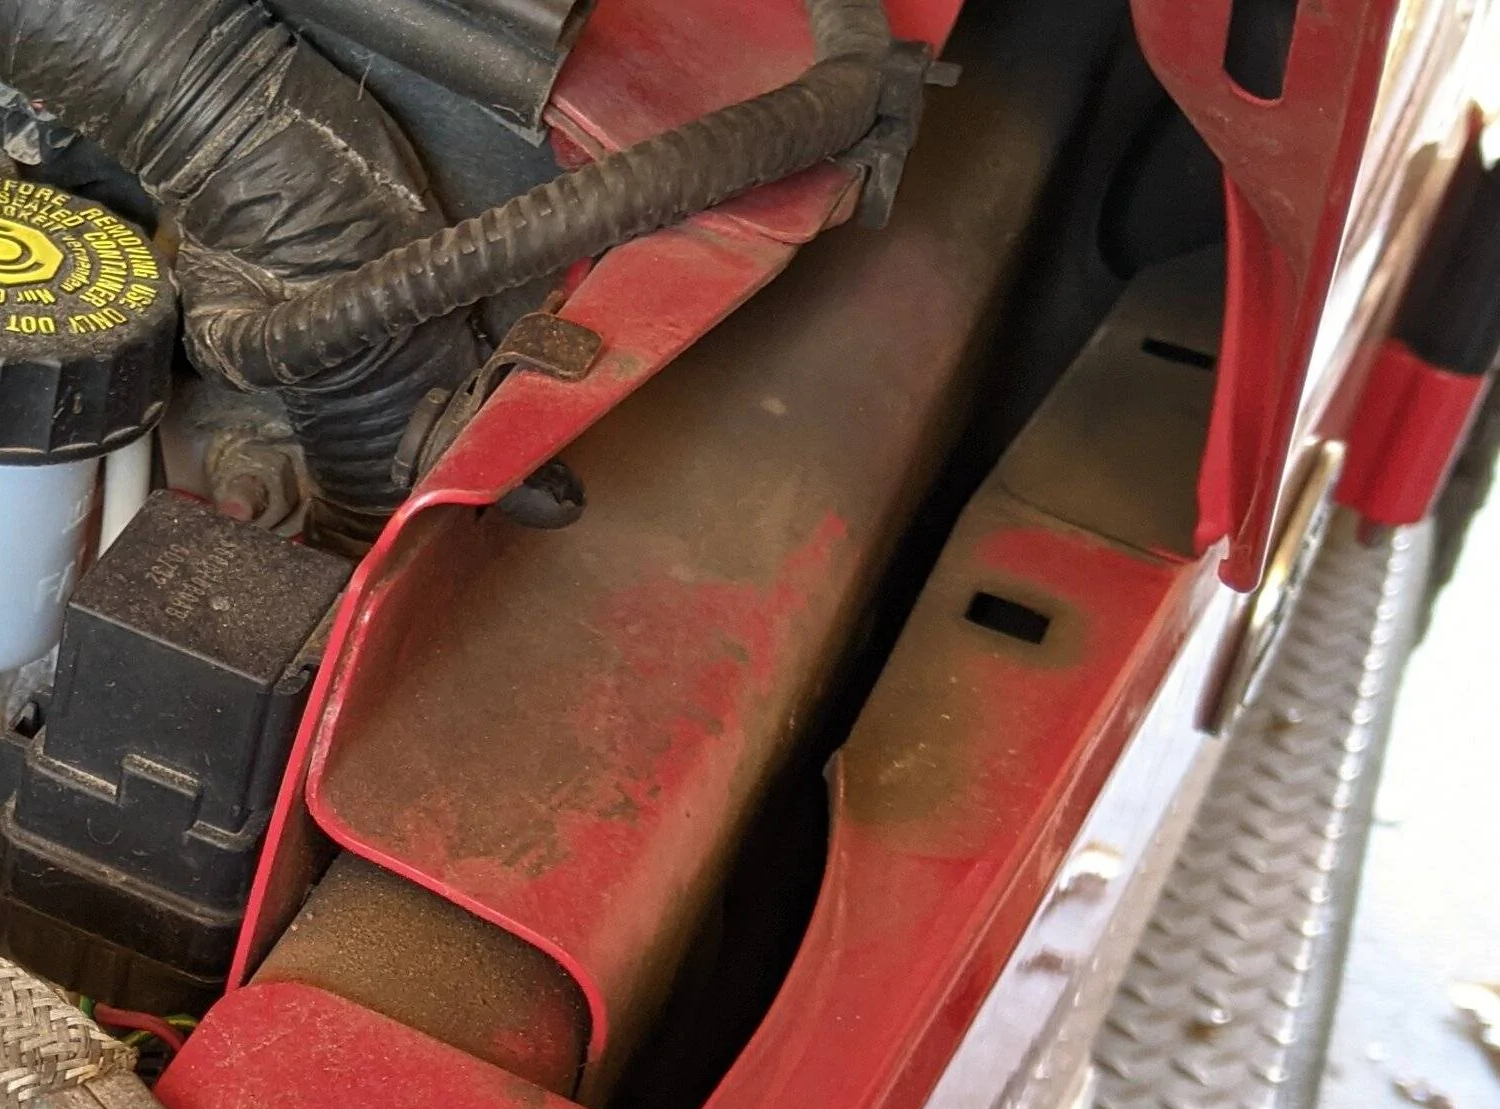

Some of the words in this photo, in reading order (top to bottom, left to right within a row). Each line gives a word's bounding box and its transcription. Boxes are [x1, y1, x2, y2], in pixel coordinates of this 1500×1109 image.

[80, 208, 159, 279] REMOVING
[79, 232, 128, 307] CONTAINER
[5, 314, 55, 334] DOT
[68, 307, 129, 334] ONLY
